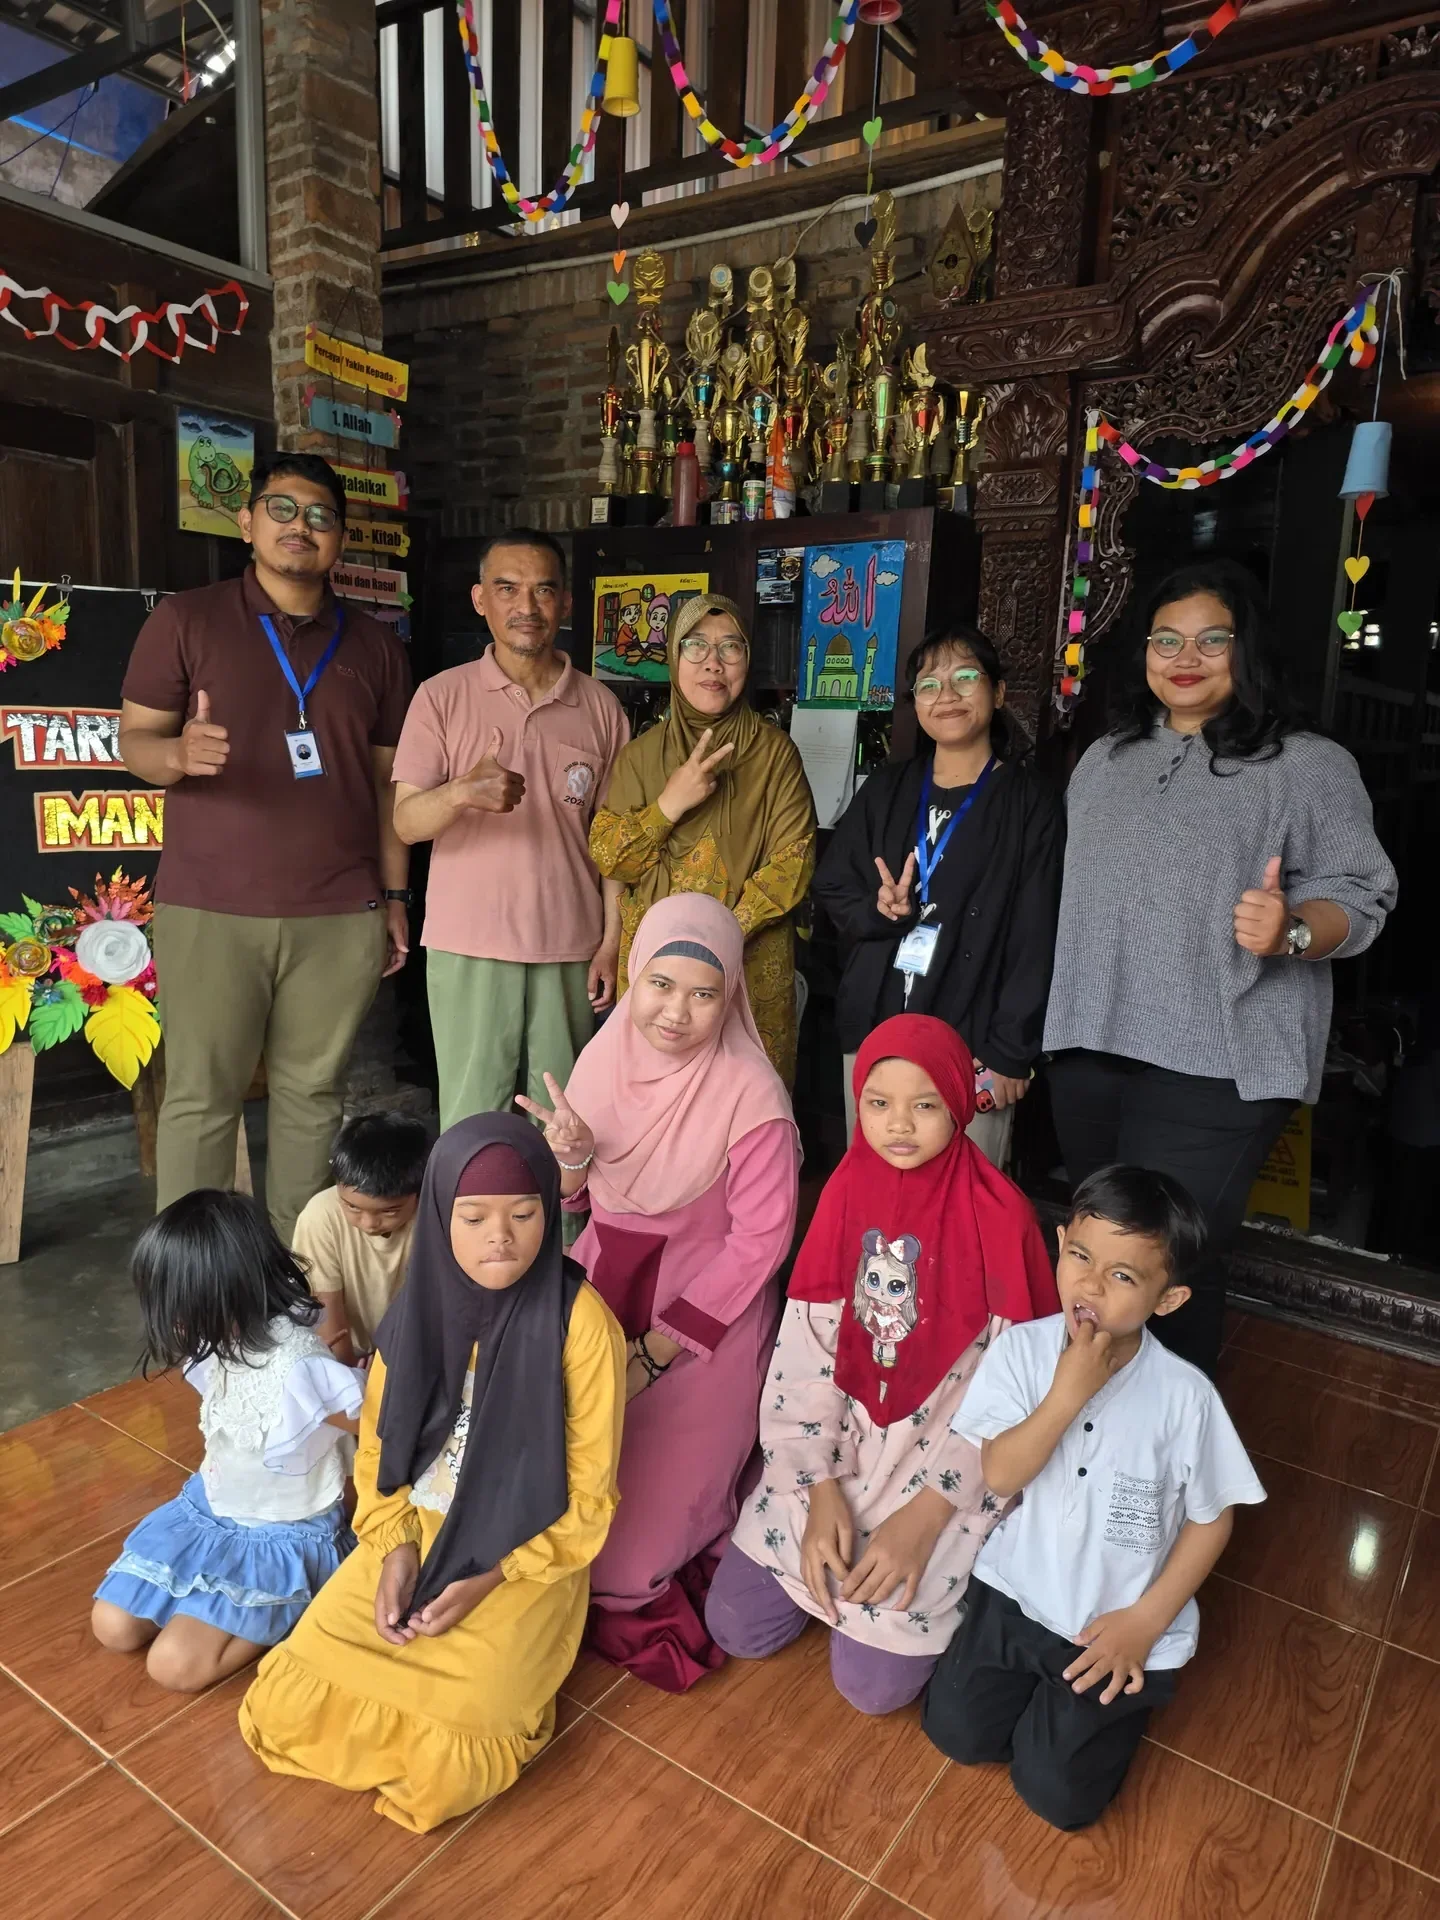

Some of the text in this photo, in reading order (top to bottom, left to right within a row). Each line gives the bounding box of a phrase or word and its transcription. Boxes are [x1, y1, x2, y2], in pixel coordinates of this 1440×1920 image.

[345, 357, 365, 373] Yakin
[366, 365, 393, 382] Kepada
[332, 410, 372, 434] 1. Allah
[372, 528, 402, 546] Kitab
[354, 575, 371, 589] dan
[372, 578, 397, 592] Rasul
